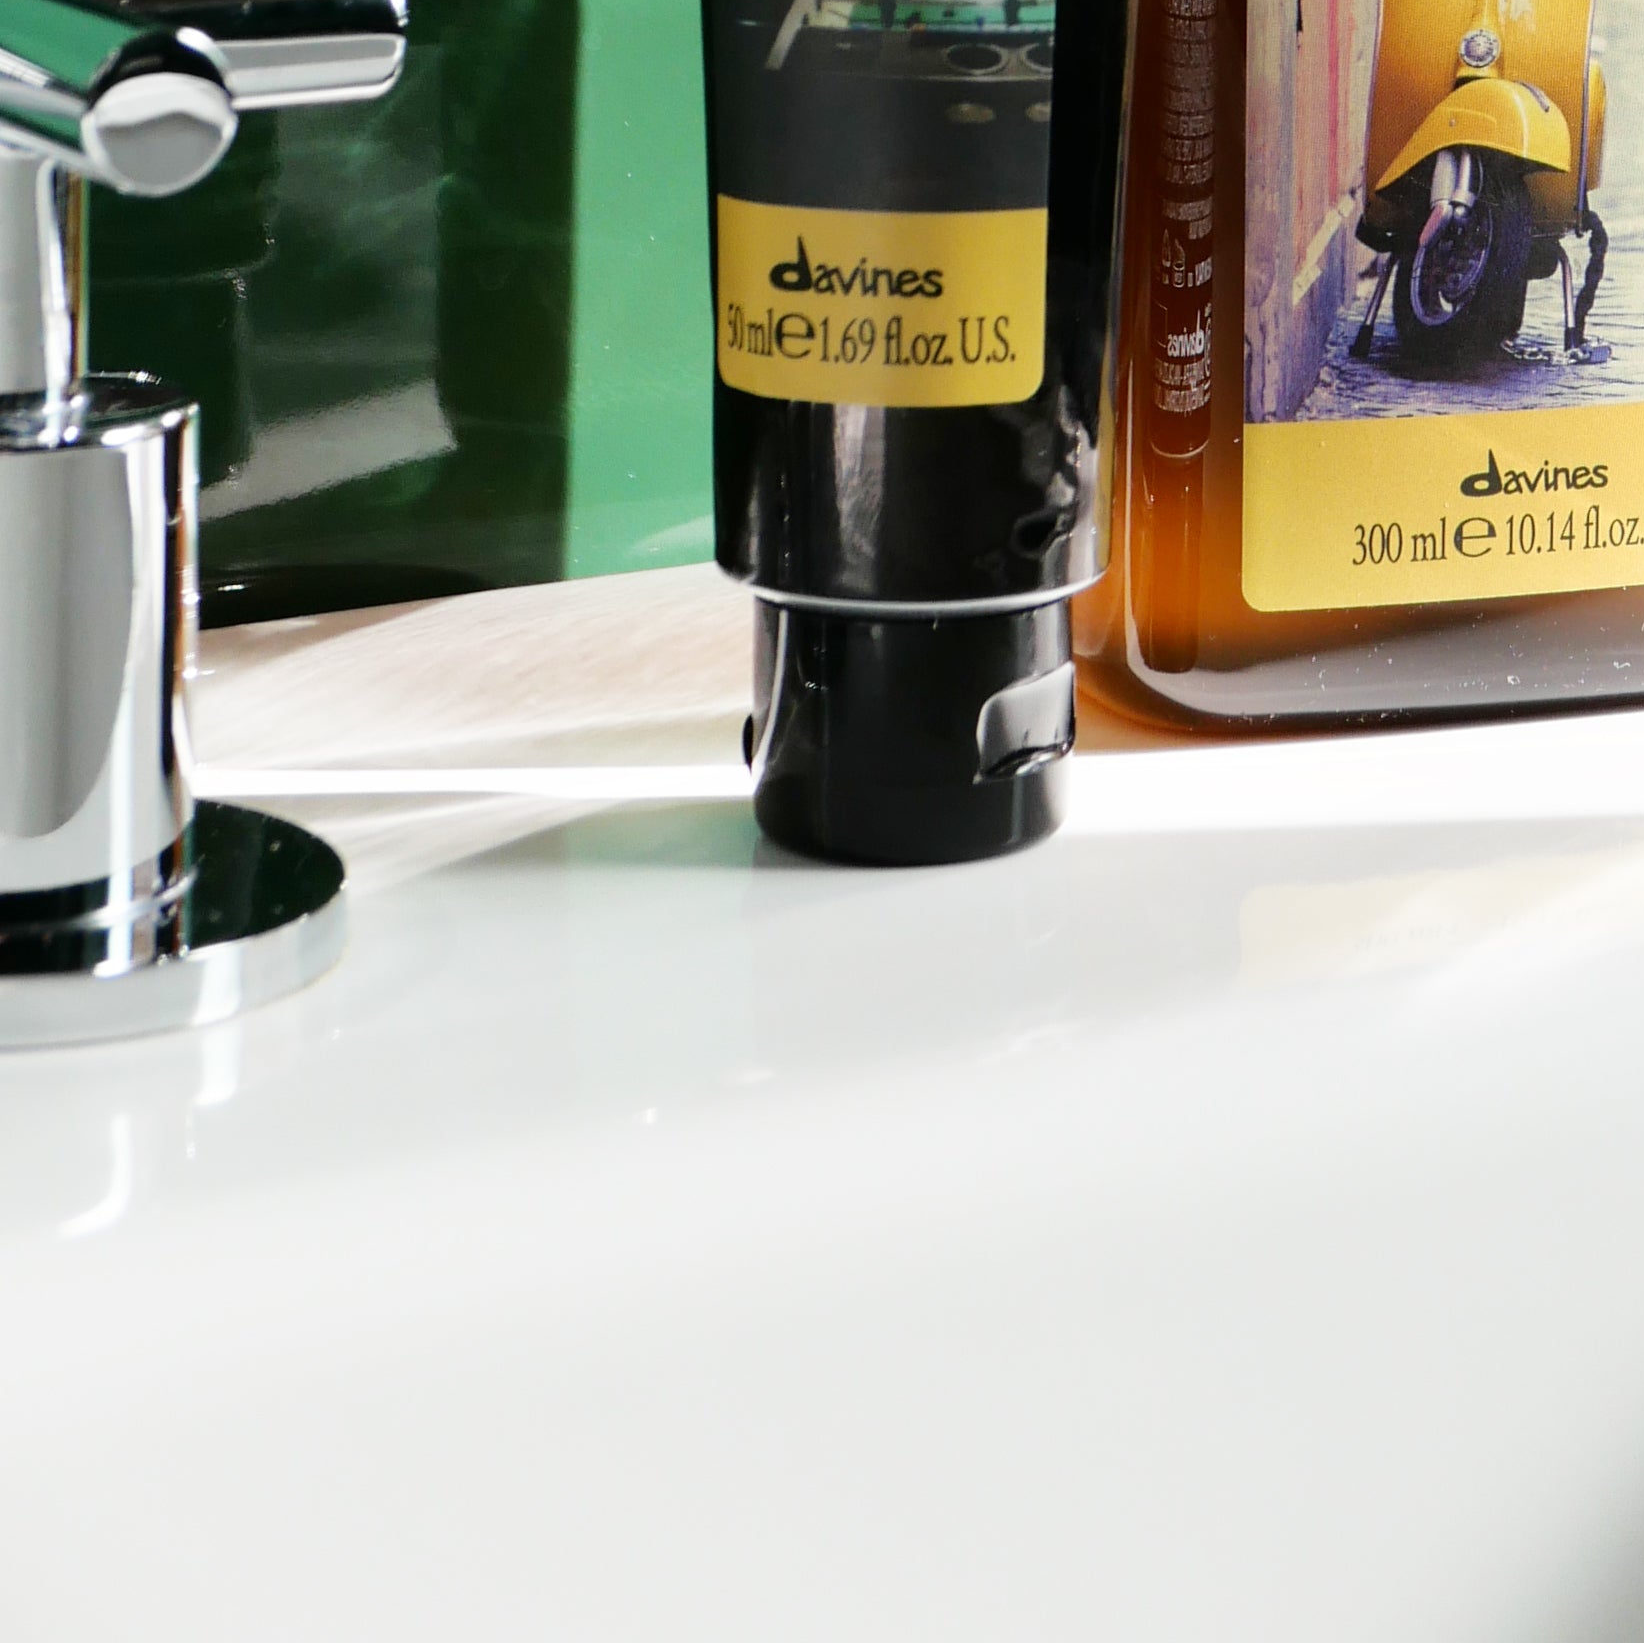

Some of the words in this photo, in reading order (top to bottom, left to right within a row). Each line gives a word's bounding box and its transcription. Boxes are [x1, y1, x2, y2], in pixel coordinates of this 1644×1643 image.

[769, 235, 944, 298] davines
[748, 307, 774, 358] ml
[819, 315, 877, 366] 1.69
[958, 314, 1016, 365] U.S.
[1460, 448, 1609, 497] davines
[1352, 521, 1403, 567] 300
[1410, 516, 1447, 564] ml
[1505, 508, 1577, 556] 10.14
